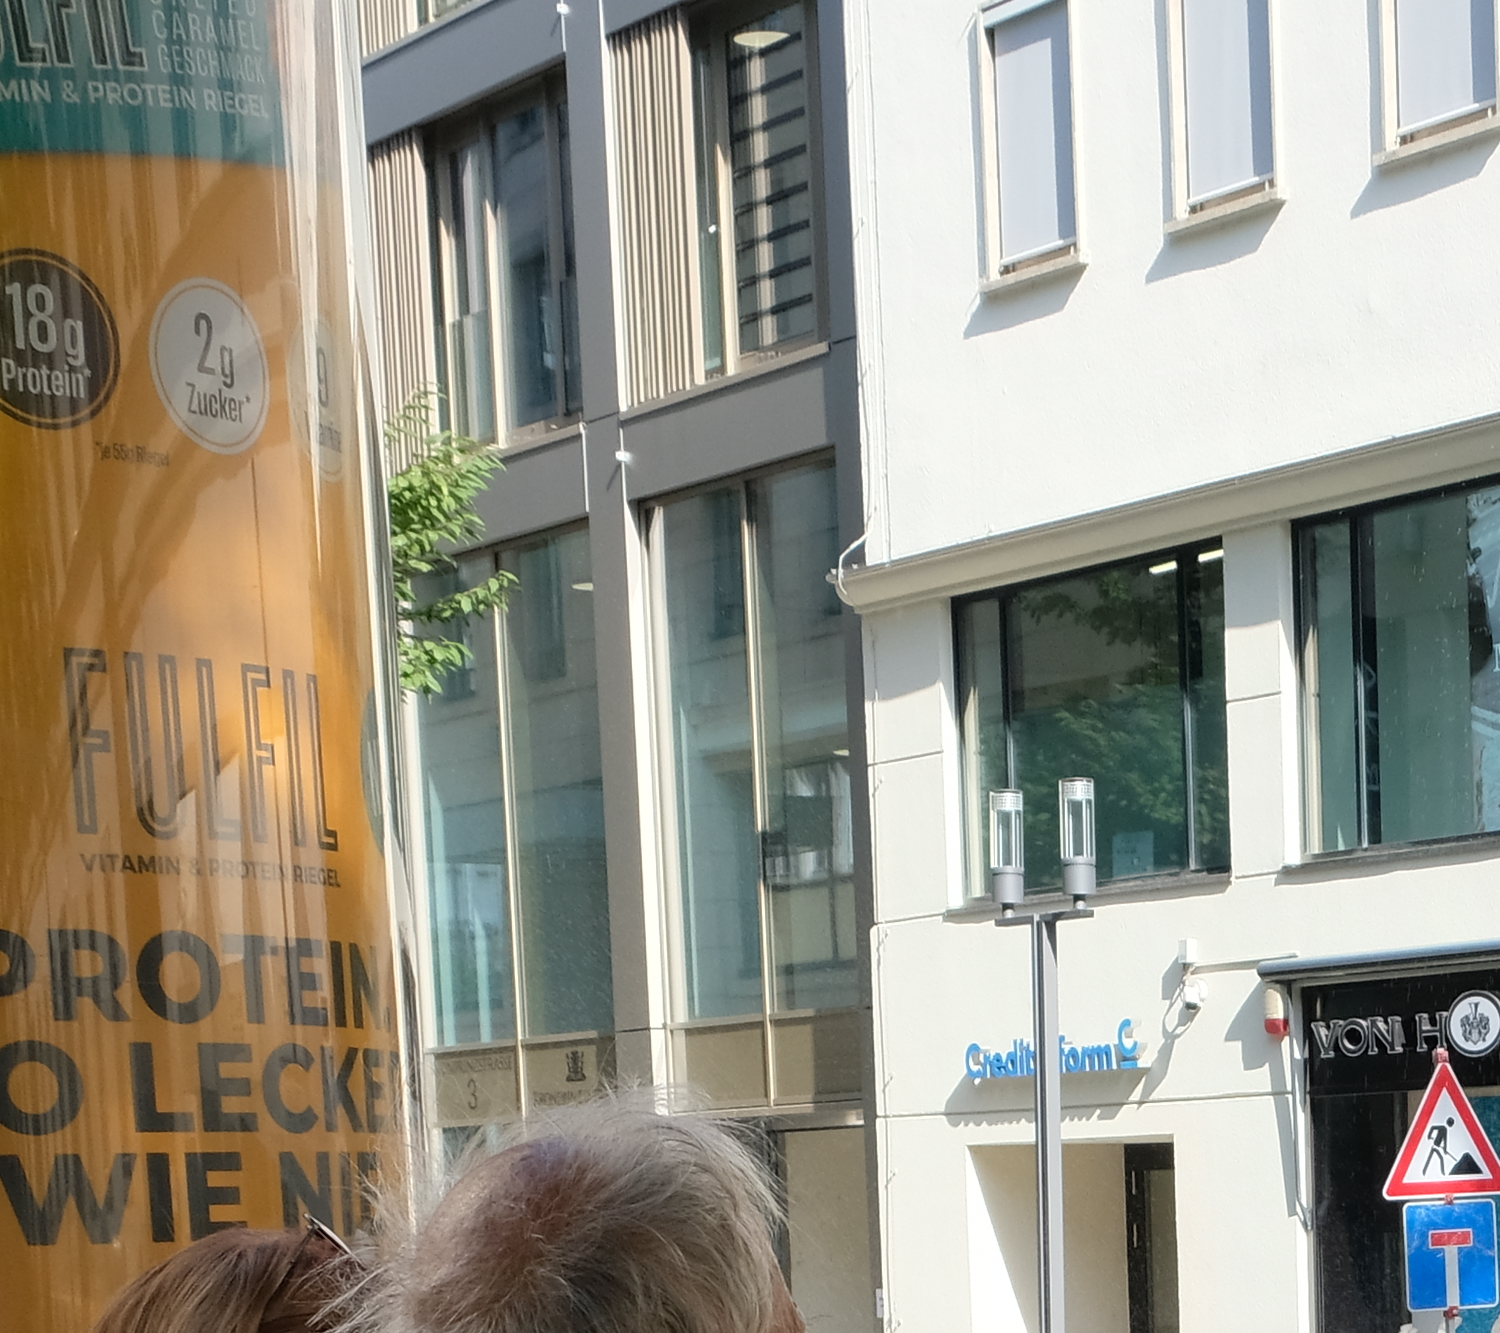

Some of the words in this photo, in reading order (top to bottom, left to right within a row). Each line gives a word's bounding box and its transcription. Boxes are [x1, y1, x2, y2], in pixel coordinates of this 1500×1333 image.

[152, 10, 261, 50] CARAMEL
[157, 44, 266, 84] GESCHMACK
[63, 79, 80, 101] &
[88, 81, 198, 110] PROTEIN
[203, 88, 269, 118] RIEGEL
[63, 646, 339, 852] FULFIL
[79, 852, 182, 877] VITAMIN
[208, 861, 286, 881] PROTEIN
[291, 864, 342, 888] RIEGEL
[1311, 1016, 1403, 1058] VON
